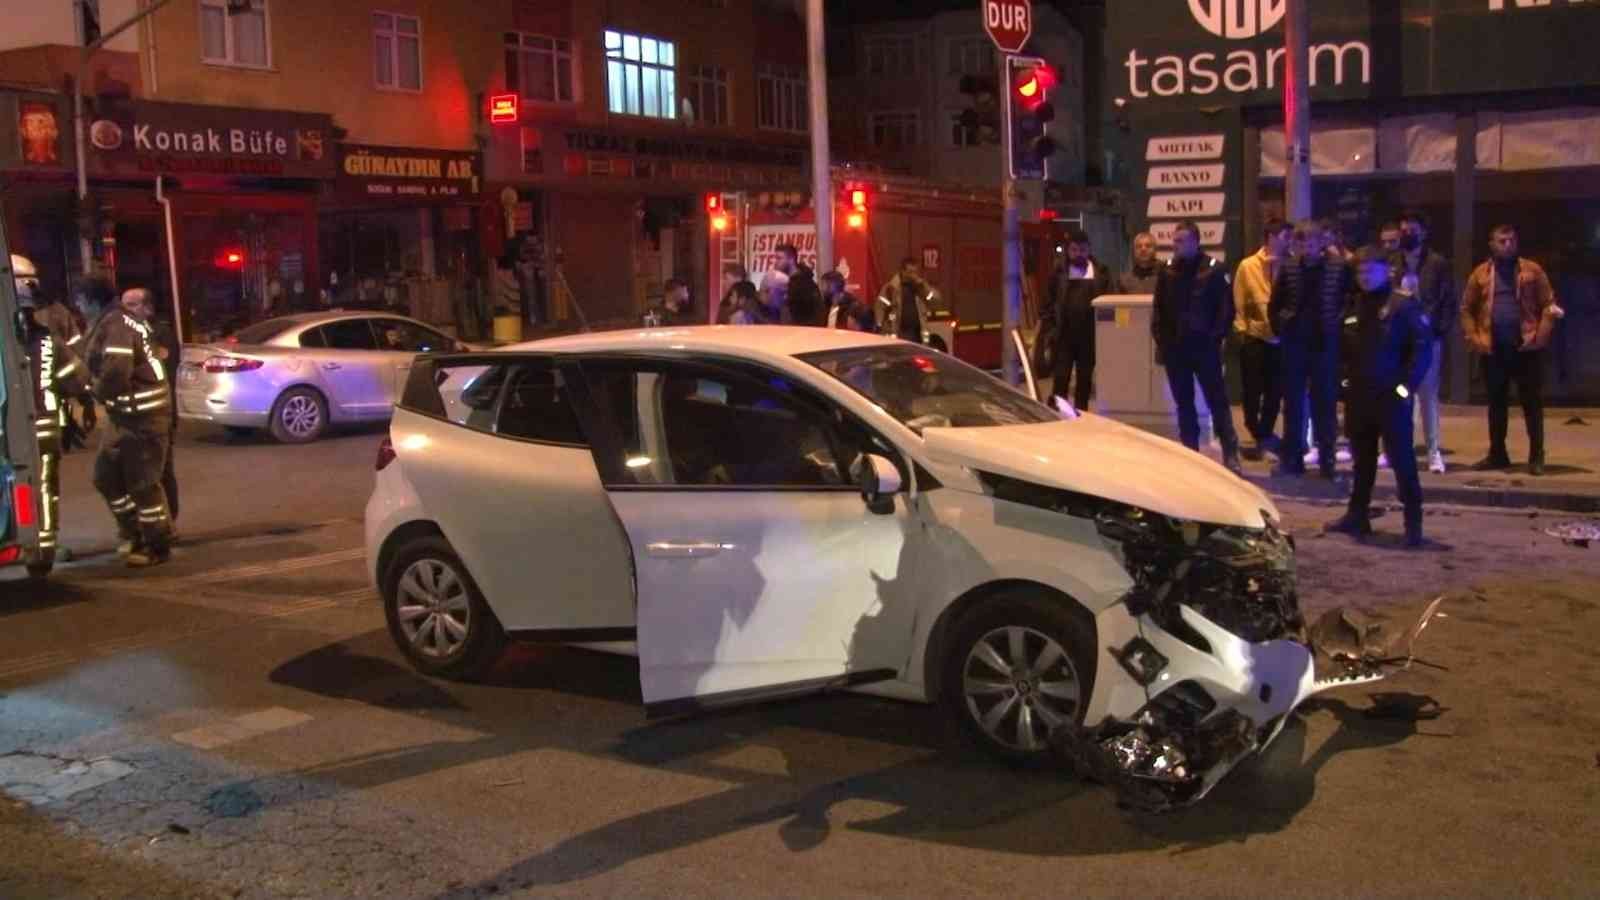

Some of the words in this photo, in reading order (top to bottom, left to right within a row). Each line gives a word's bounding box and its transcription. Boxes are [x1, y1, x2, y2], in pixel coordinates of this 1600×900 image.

[988, 2, 1026, 32] DUR
[1124, 41, 1370, 97] tasarm
[133, 124, 221, 152] Konak
[229, 128, 287, 154] Büfe
[1158, 142, 1214, 154] MUTFAK
[344, 150, 441, 177] GÜNAYDIN
[1161, 171, 1210, 184] BANYO
[1167, 200, 1203, 213] KAPI
[752, 232, 816, 252] İSTANBU
[923, 249, 940, 268] 112
